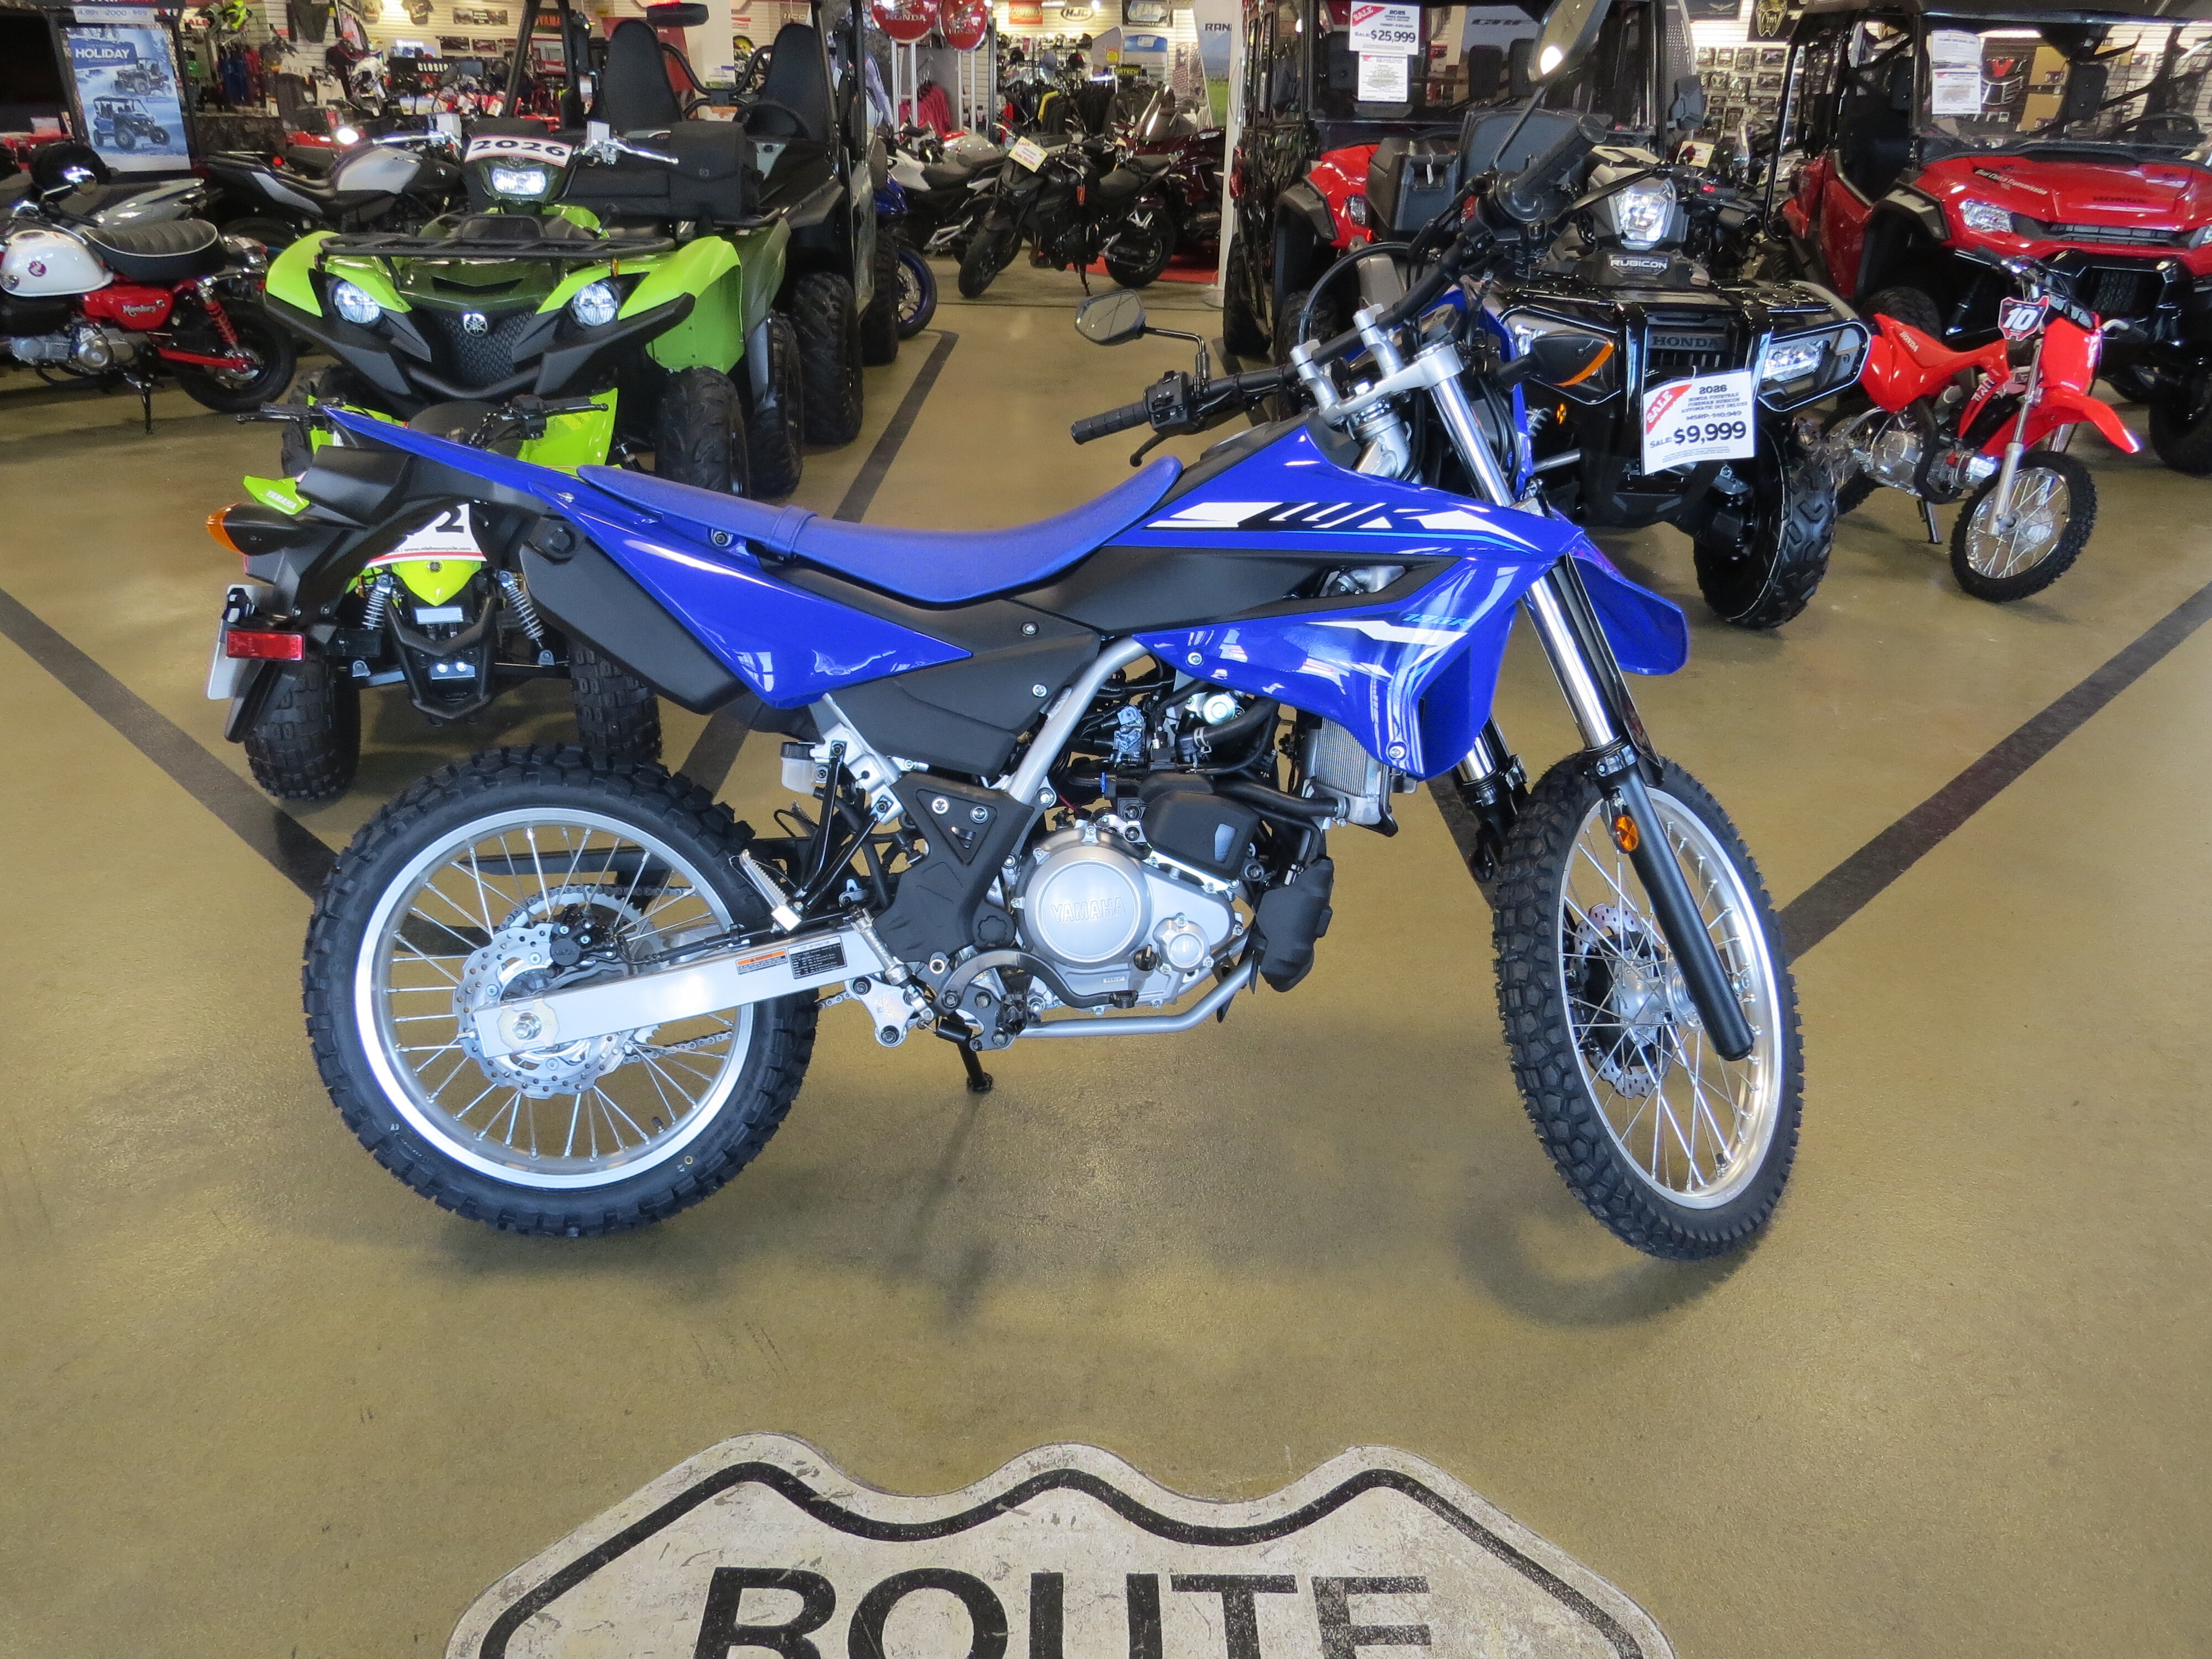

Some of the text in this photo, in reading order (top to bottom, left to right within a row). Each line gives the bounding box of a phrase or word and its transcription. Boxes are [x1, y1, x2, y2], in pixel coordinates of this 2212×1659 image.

[1353, 6, 1374, 21] SALE
[1204, 23, 1232, 32] RAN
[1370, 29, 1416, 44] $25,999
[75, 48, 130, 59] HOLIDAY
[472, 139, 566, 156] 2026
[1610, 258, 1667, 270] RUBICON
[123, 304, 156, 317] Monkey
[2003, 307, 2039, 331] 10
[1651, 336, 1720, 347] HONDA
[1900, 331, 1919, 352] HONDA
[1699, 384, 1727, 394] 2026
[1646, 390, 1674, 424] SALE
[1673, 421, 1746, 446] $9,999
[266, 490, 298, 510] YAMAHA
[1402, 613, 1472, 627] 125R
[1050, 897, 1126, 924] YAMAHA
[691, 1565, 1433, 1659] ROUTE
